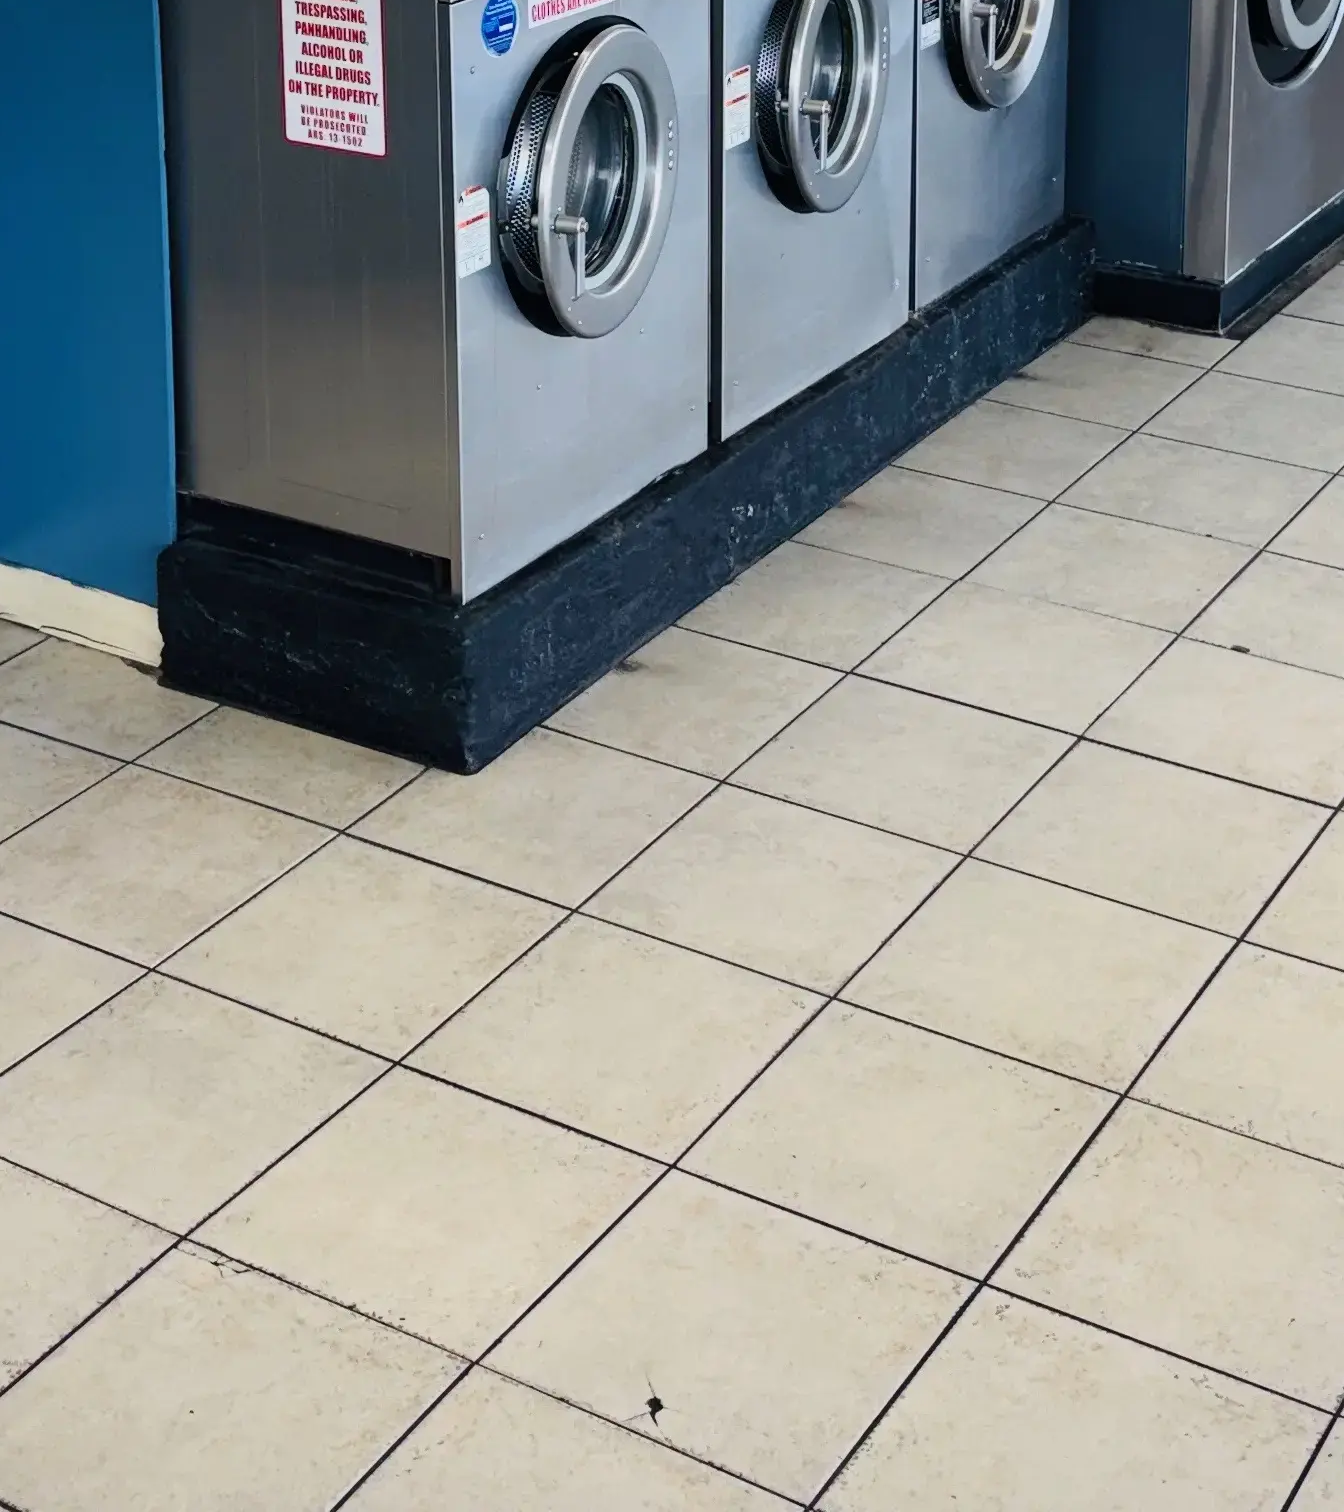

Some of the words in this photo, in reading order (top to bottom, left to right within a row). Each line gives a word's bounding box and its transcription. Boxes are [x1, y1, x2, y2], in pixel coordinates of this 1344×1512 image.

[294, 0, 368, 26] TRESPASSING,
[295, 20, 369, 47] PANHANDLING,
[301, 41, 347, 62] ALCOHOL
[349, 47, 364, 65] OR
[295, 60, 333, 80] ILLEGAL
[335, 67, 371, 86] DRUGS
[288, 79, 302, 94] ON
[304, 81, 324, 98] THE
[325, 85, 380, 107] PROPERTY.
[300, 104, 346, 121] VIOLATORS
[348, 111, 369, 125] WILL
[300, 115, 311, 127] BE
